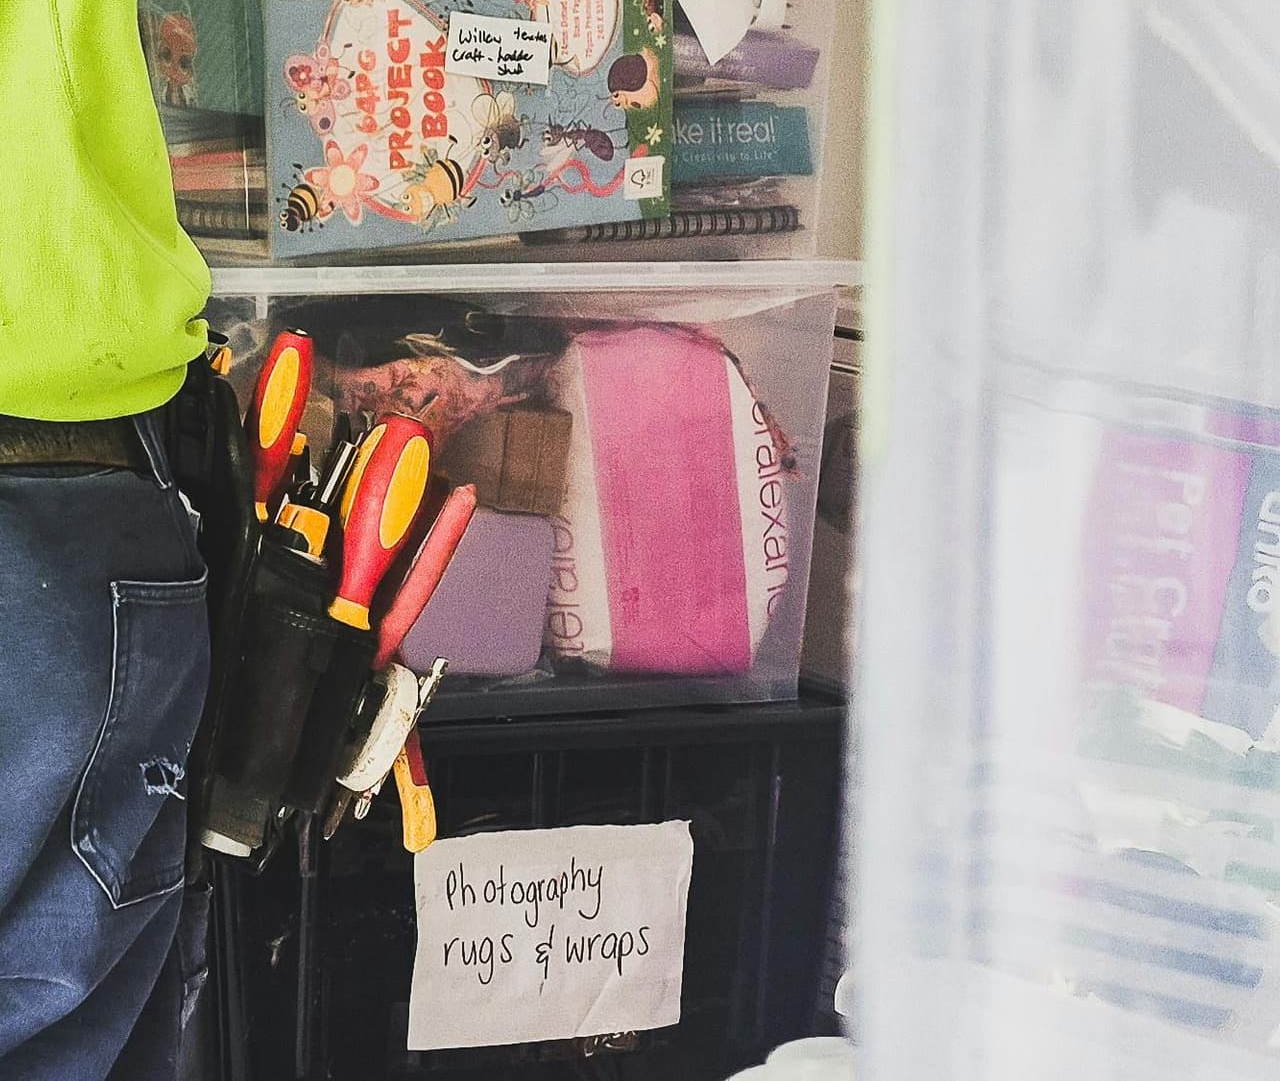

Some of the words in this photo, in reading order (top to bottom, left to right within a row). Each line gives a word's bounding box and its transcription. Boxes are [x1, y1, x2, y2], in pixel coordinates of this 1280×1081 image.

[355, 49, 380, 134] 64PG
[387, 8, 413, 170] PROJECT
[420, 35, 448, 139] BOOK
[671, 117, 704, 145] ake
[445, 856, 603, 928] Photography
[444, 933, 514, 985] rugs
[566, 925, 650, 976] wraps
